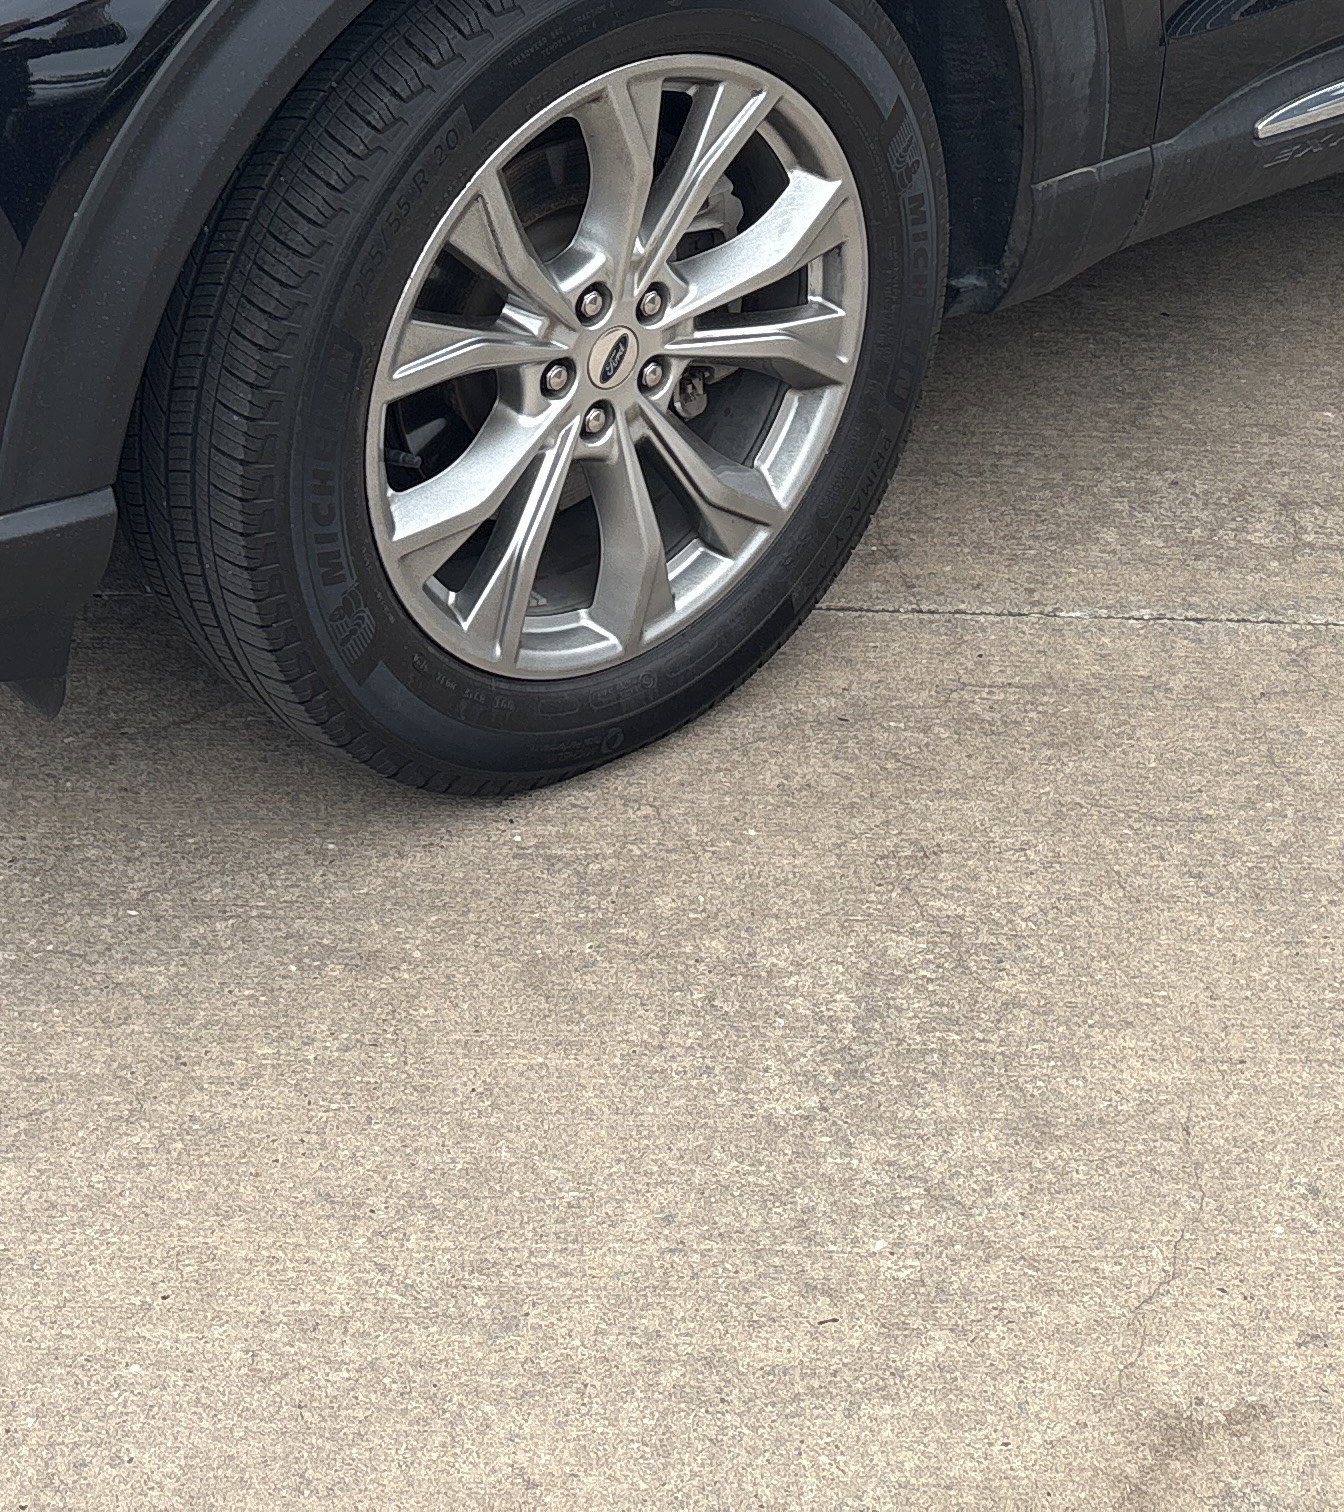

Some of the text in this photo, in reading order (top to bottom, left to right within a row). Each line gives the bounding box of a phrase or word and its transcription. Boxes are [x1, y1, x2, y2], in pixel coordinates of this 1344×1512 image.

[605, 341, 627, 377] Ford
[893, 191, 929, 400] MICHELIN
[309, 343, 356, 587] MICHELIN
[835, 437, 893, 549] PRIMACY
